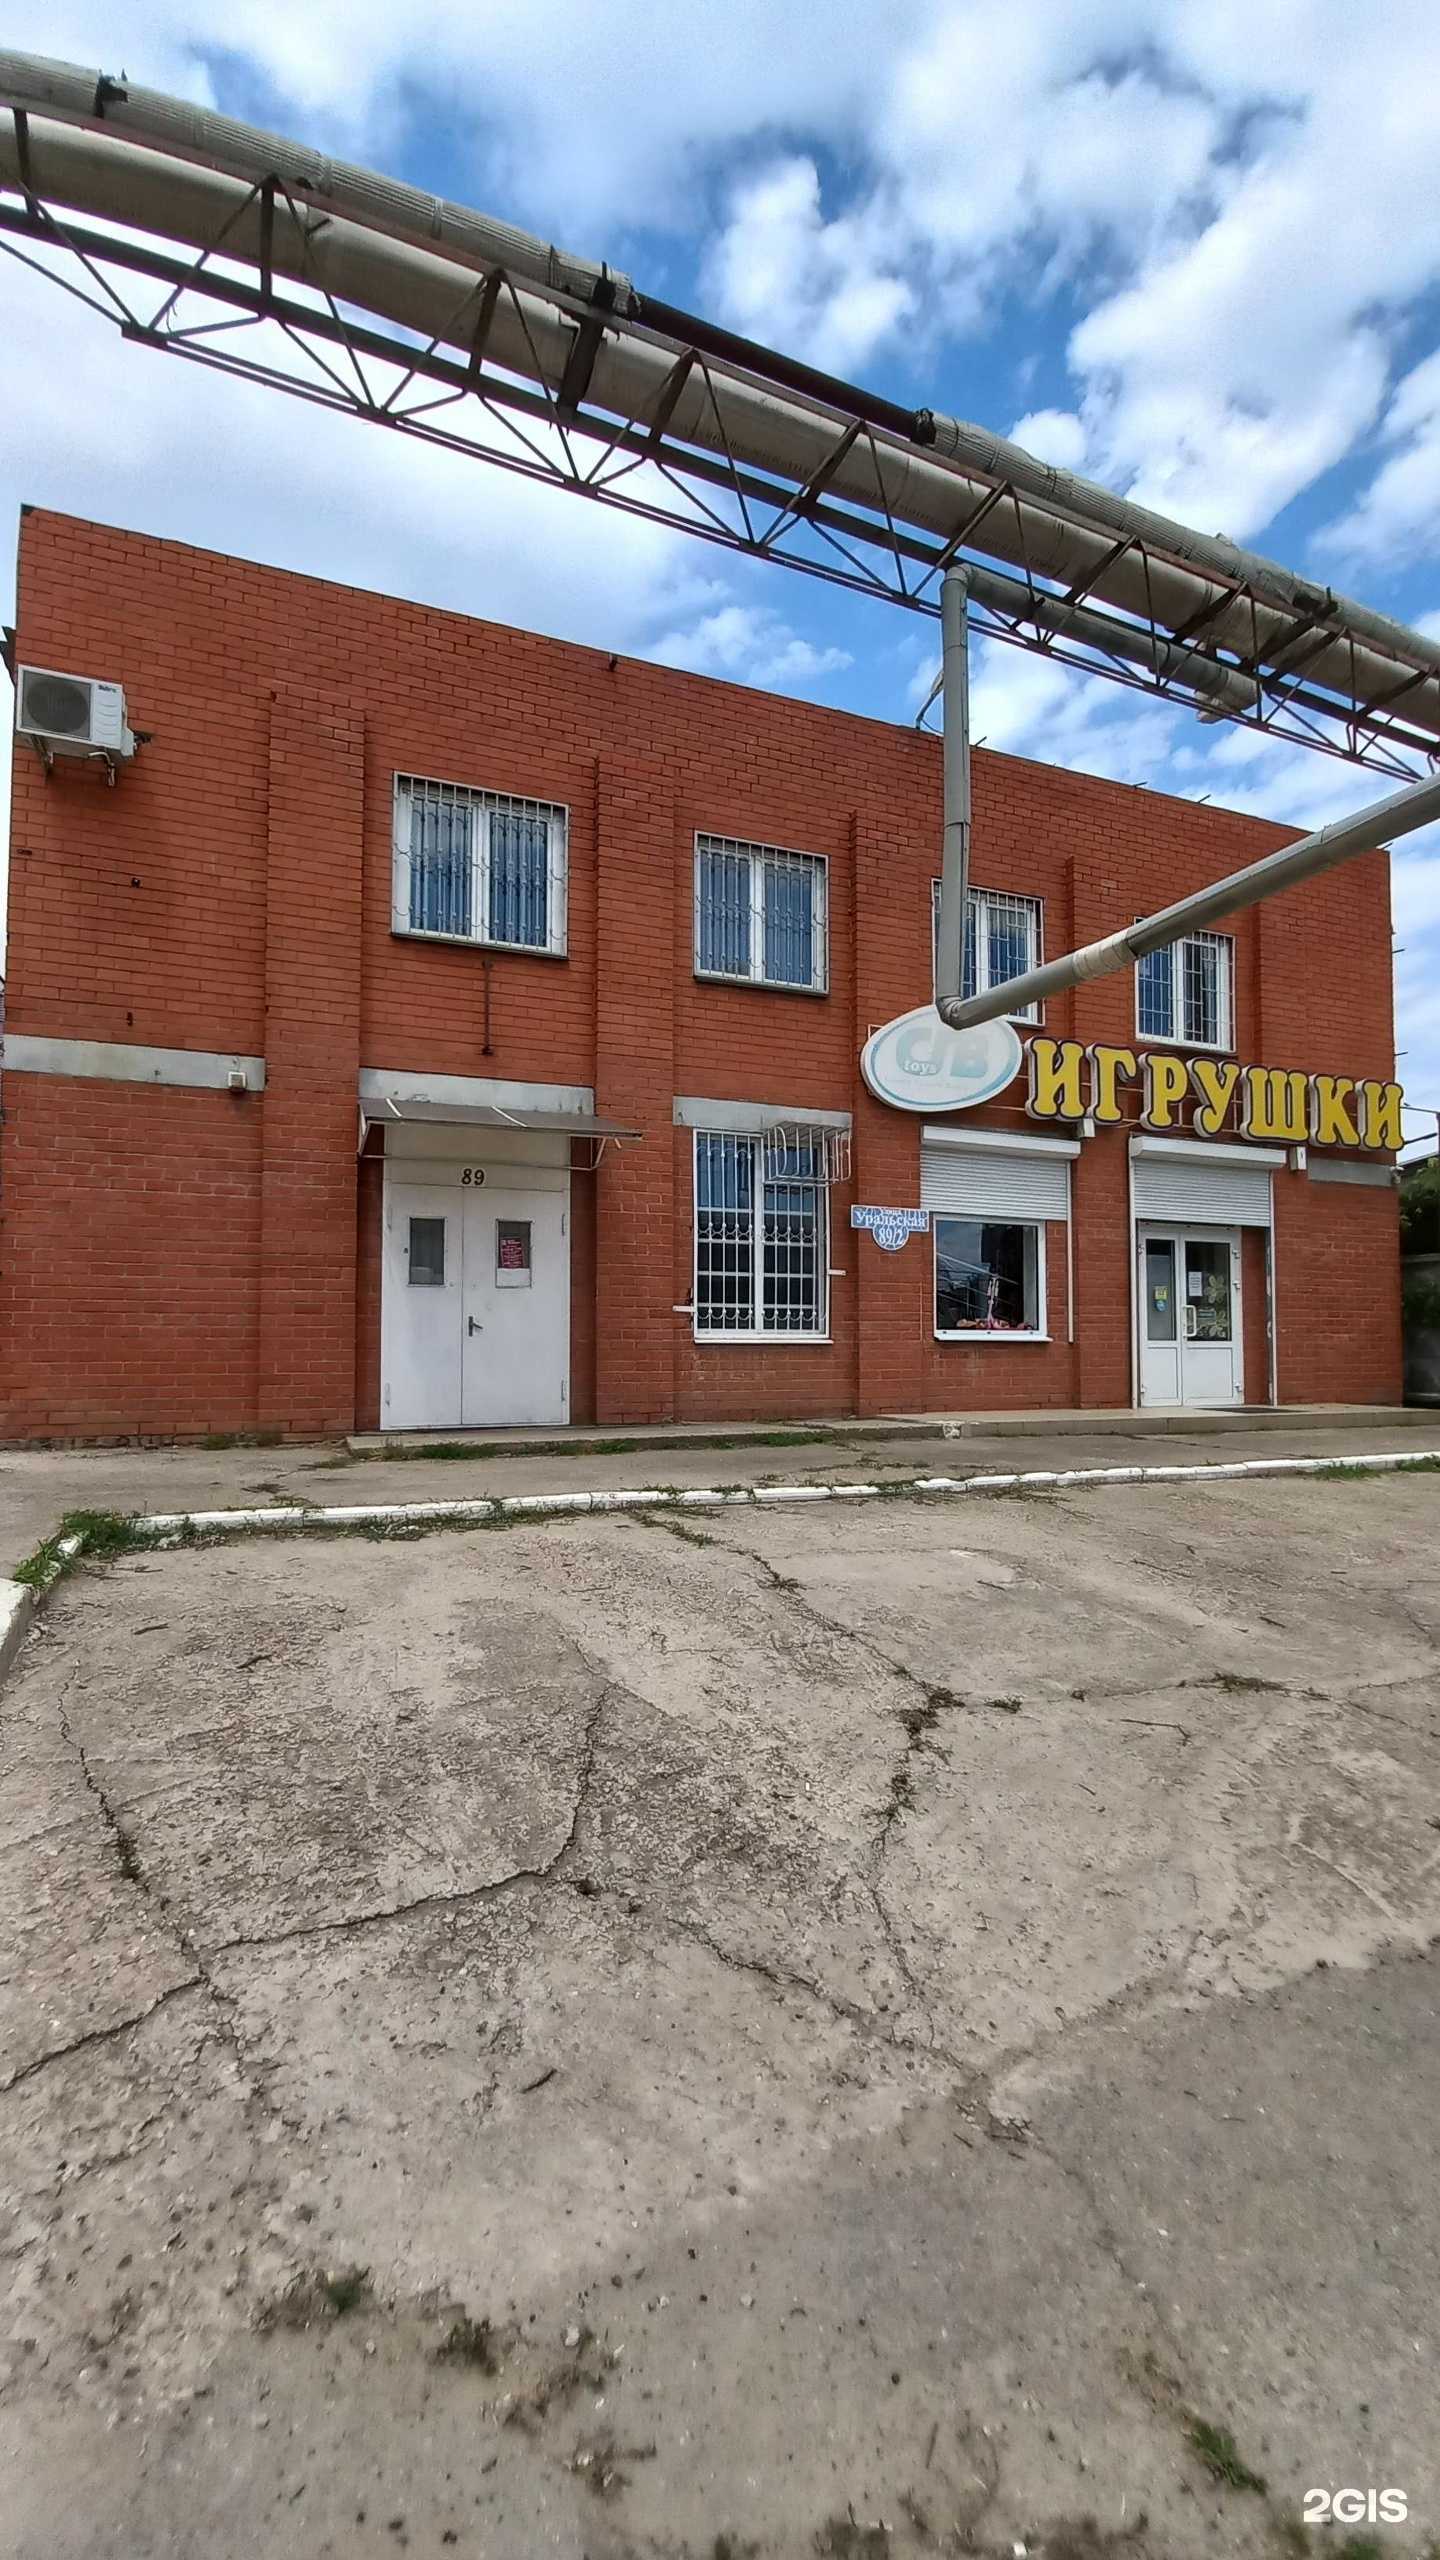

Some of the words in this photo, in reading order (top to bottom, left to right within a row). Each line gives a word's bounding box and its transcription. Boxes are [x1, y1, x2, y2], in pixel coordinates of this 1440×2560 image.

[903, 1060, 938, 1076] toys
[1026, 1037, 1405, 1151] ИГРУШКИ
[461, 1168, 486, 1186] 89
[854, 1210, 926, 1227] Уральская
[878, 1227, 906, 1245] 89/2
